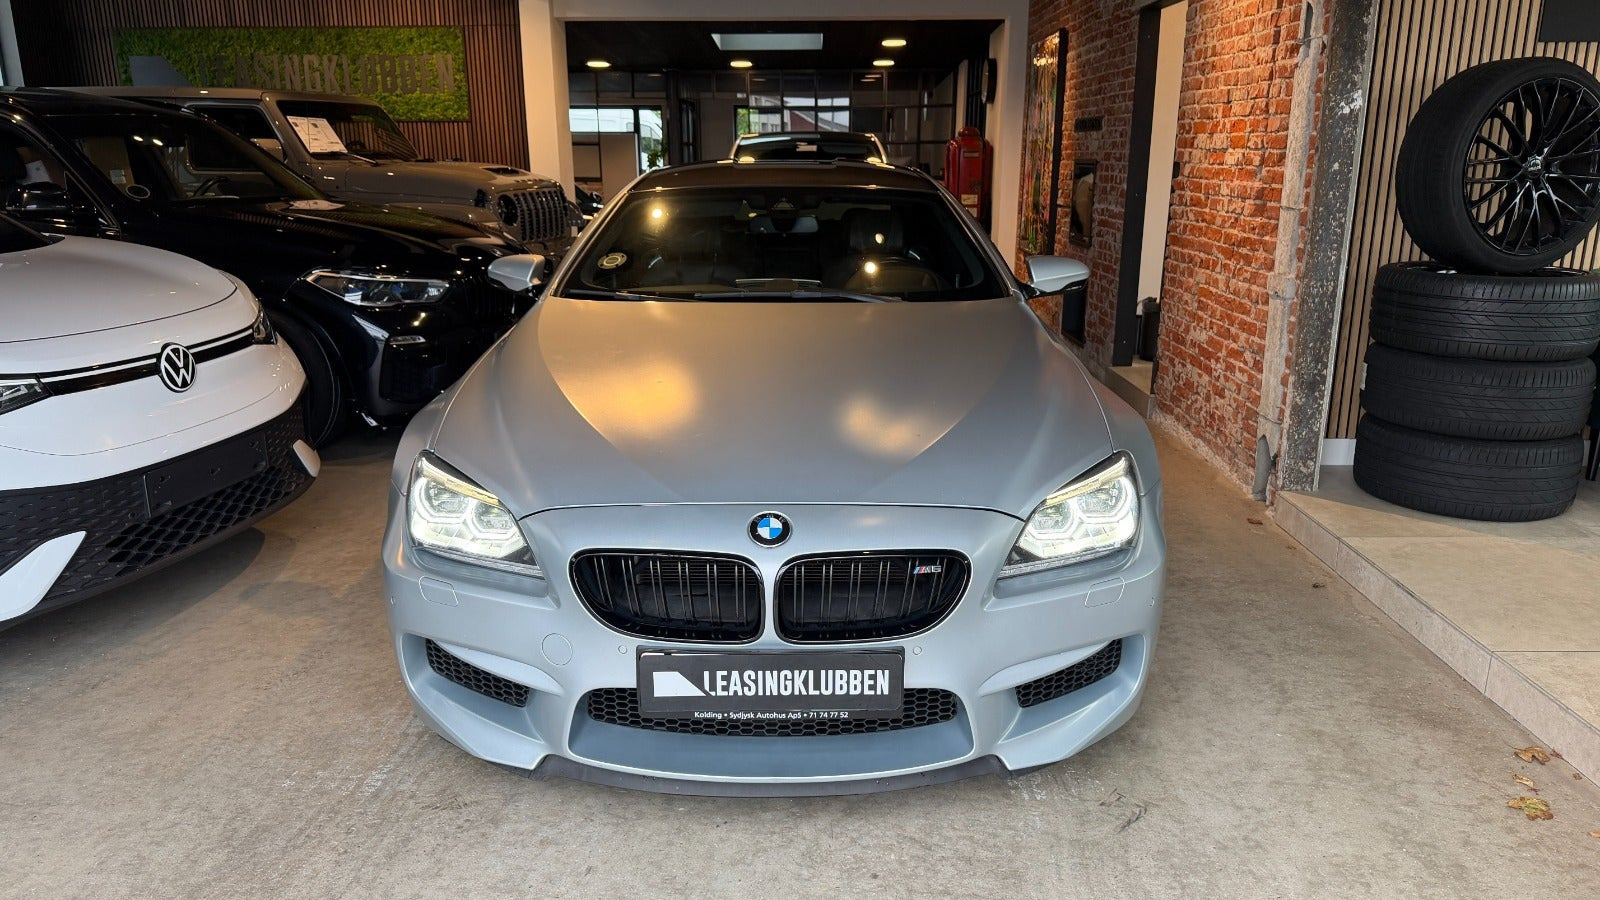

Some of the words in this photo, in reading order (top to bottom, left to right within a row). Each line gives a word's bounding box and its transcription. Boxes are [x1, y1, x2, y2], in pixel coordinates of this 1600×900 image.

[703, 669, 890, 697] LEASINGKLUBBEN
[694, 711, 723, 720] Kolding
[729, 711, 755, 720] Sydjysk
[756, 711, 786, 719] Autohus
[787, 711, 802, 720] ApS
[809, 711, 817, 719] 71
[819, 711, 828, 719] 74
[829, 711, 838, 719] 77
[839, 711, 849, 719] 52
